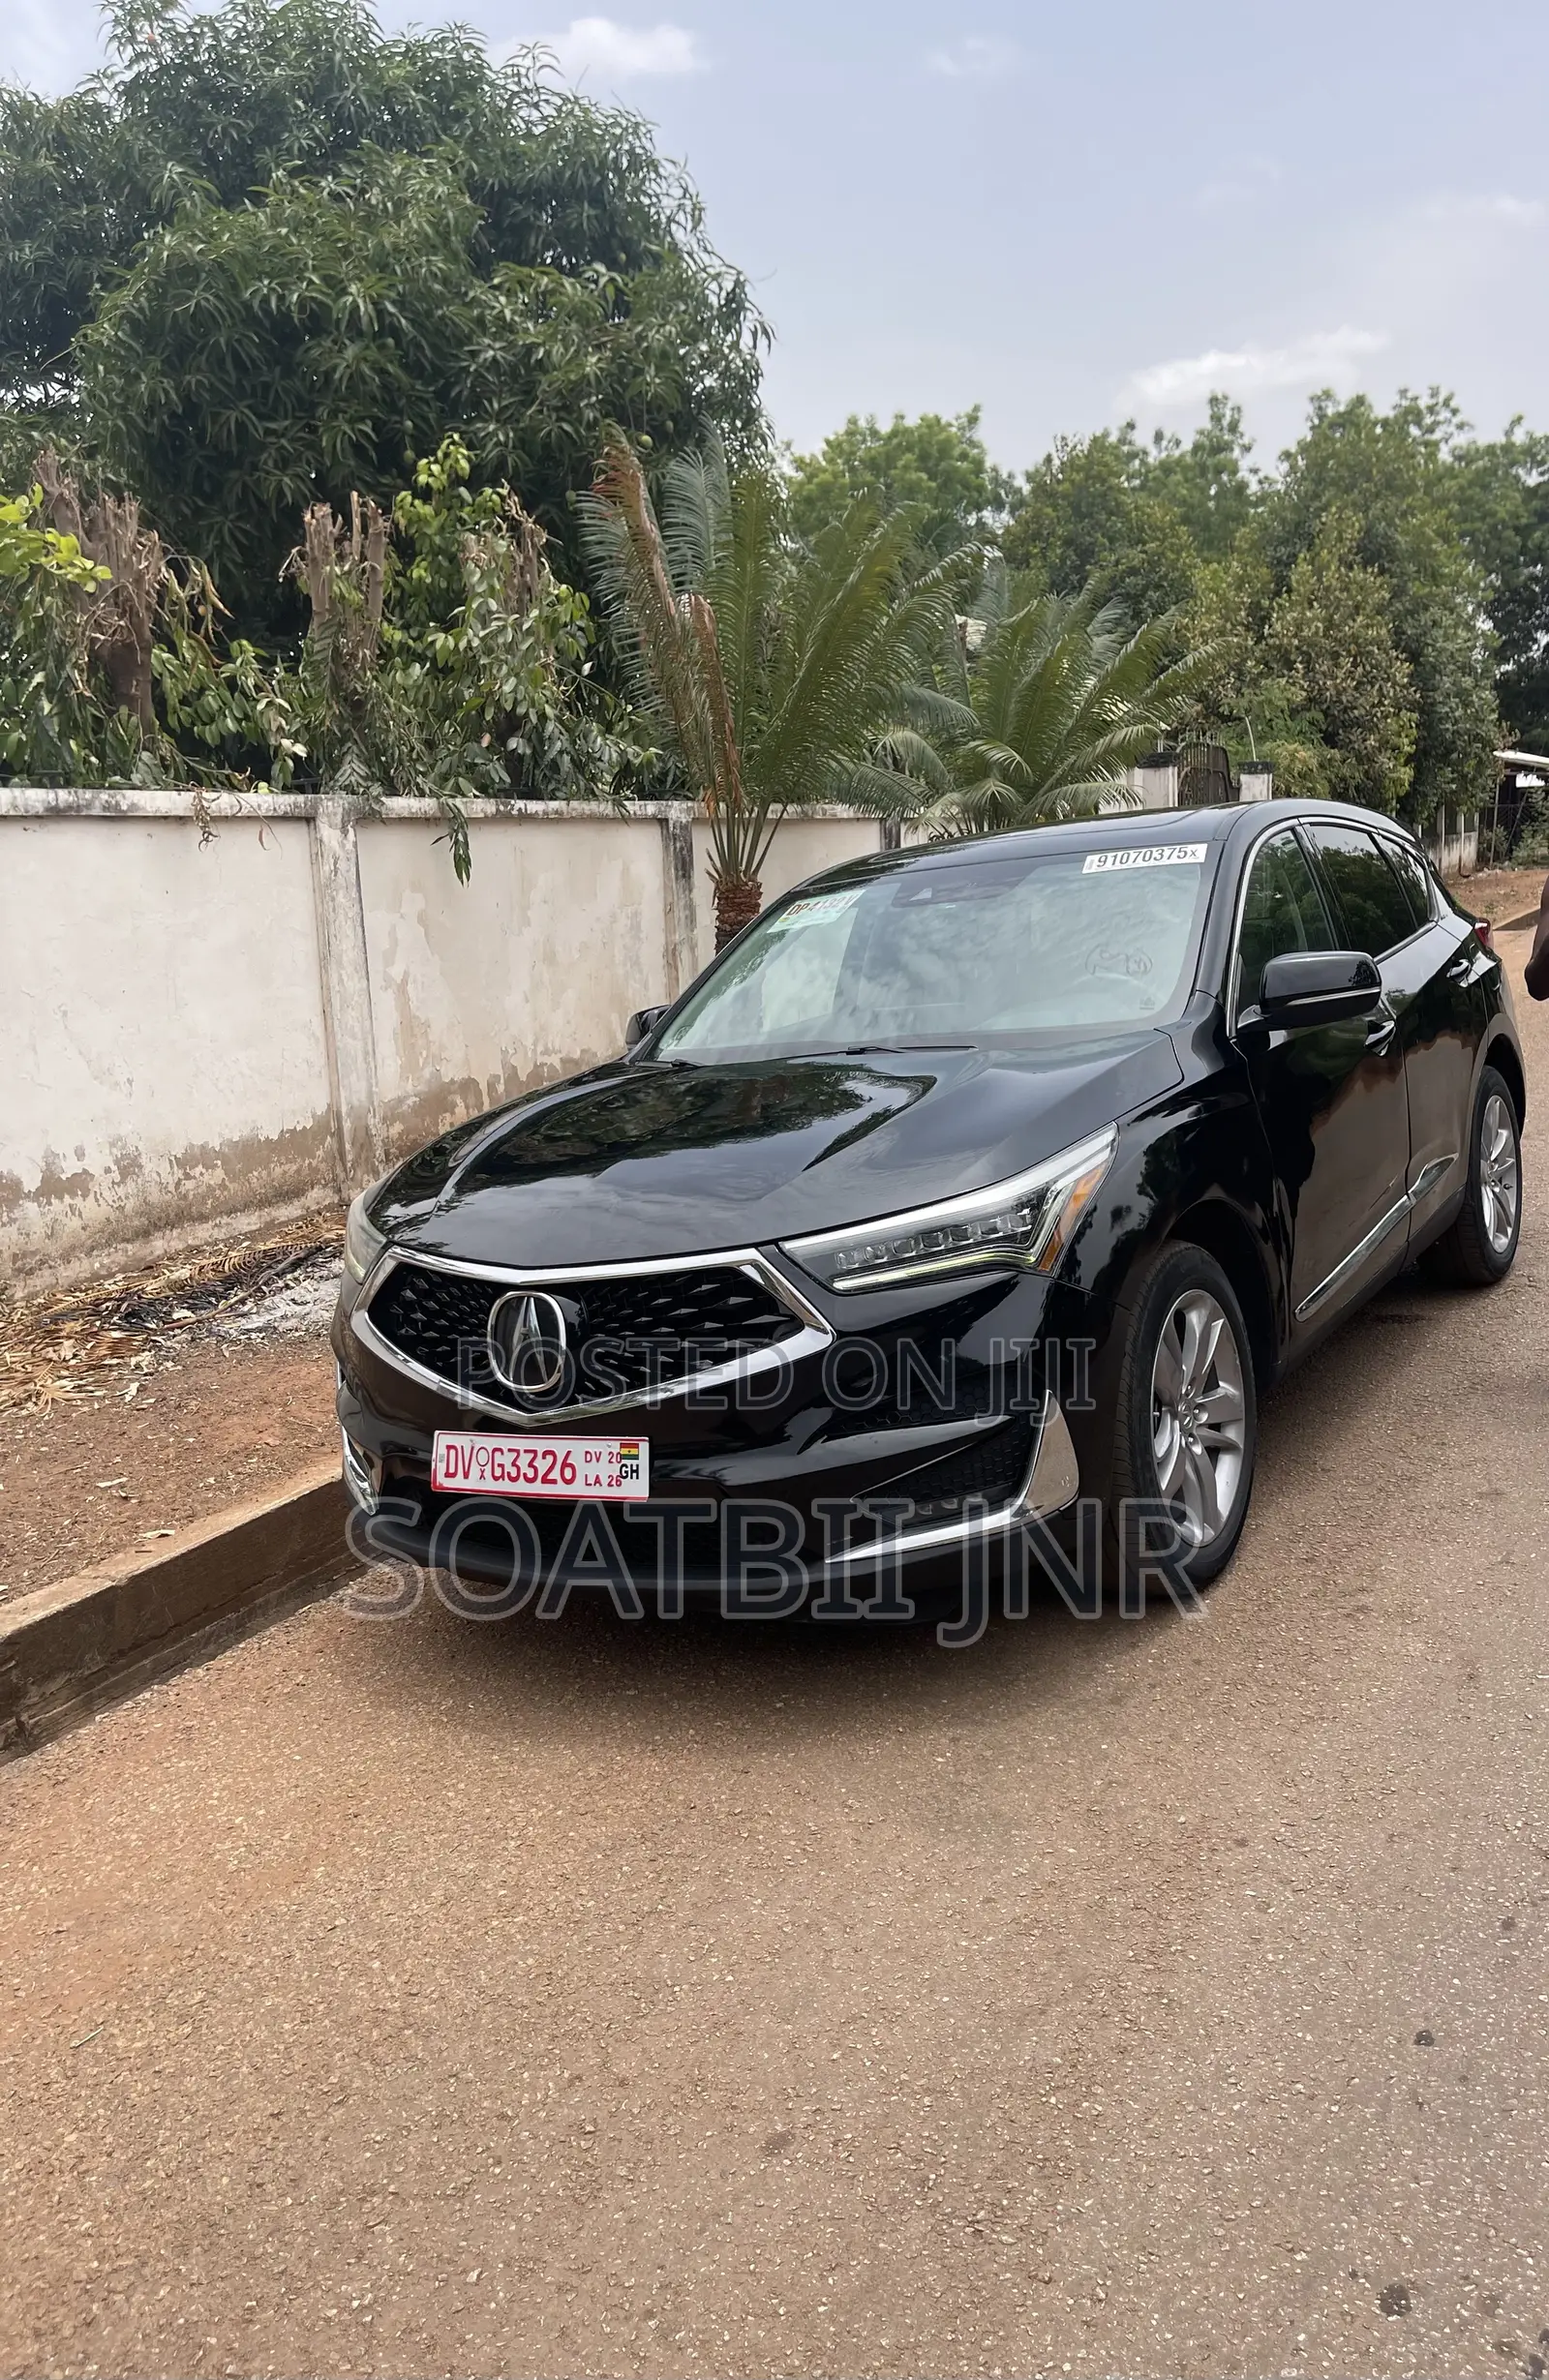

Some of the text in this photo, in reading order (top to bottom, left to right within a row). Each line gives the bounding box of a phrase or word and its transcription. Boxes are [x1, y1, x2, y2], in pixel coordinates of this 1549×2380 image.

[786, 902, 810, 916] DP
[584, 1450, 623, 1463] DV 20
[620, 1462, 639, 1480] GH
[584, 1473, 623, 1488] LA 26
